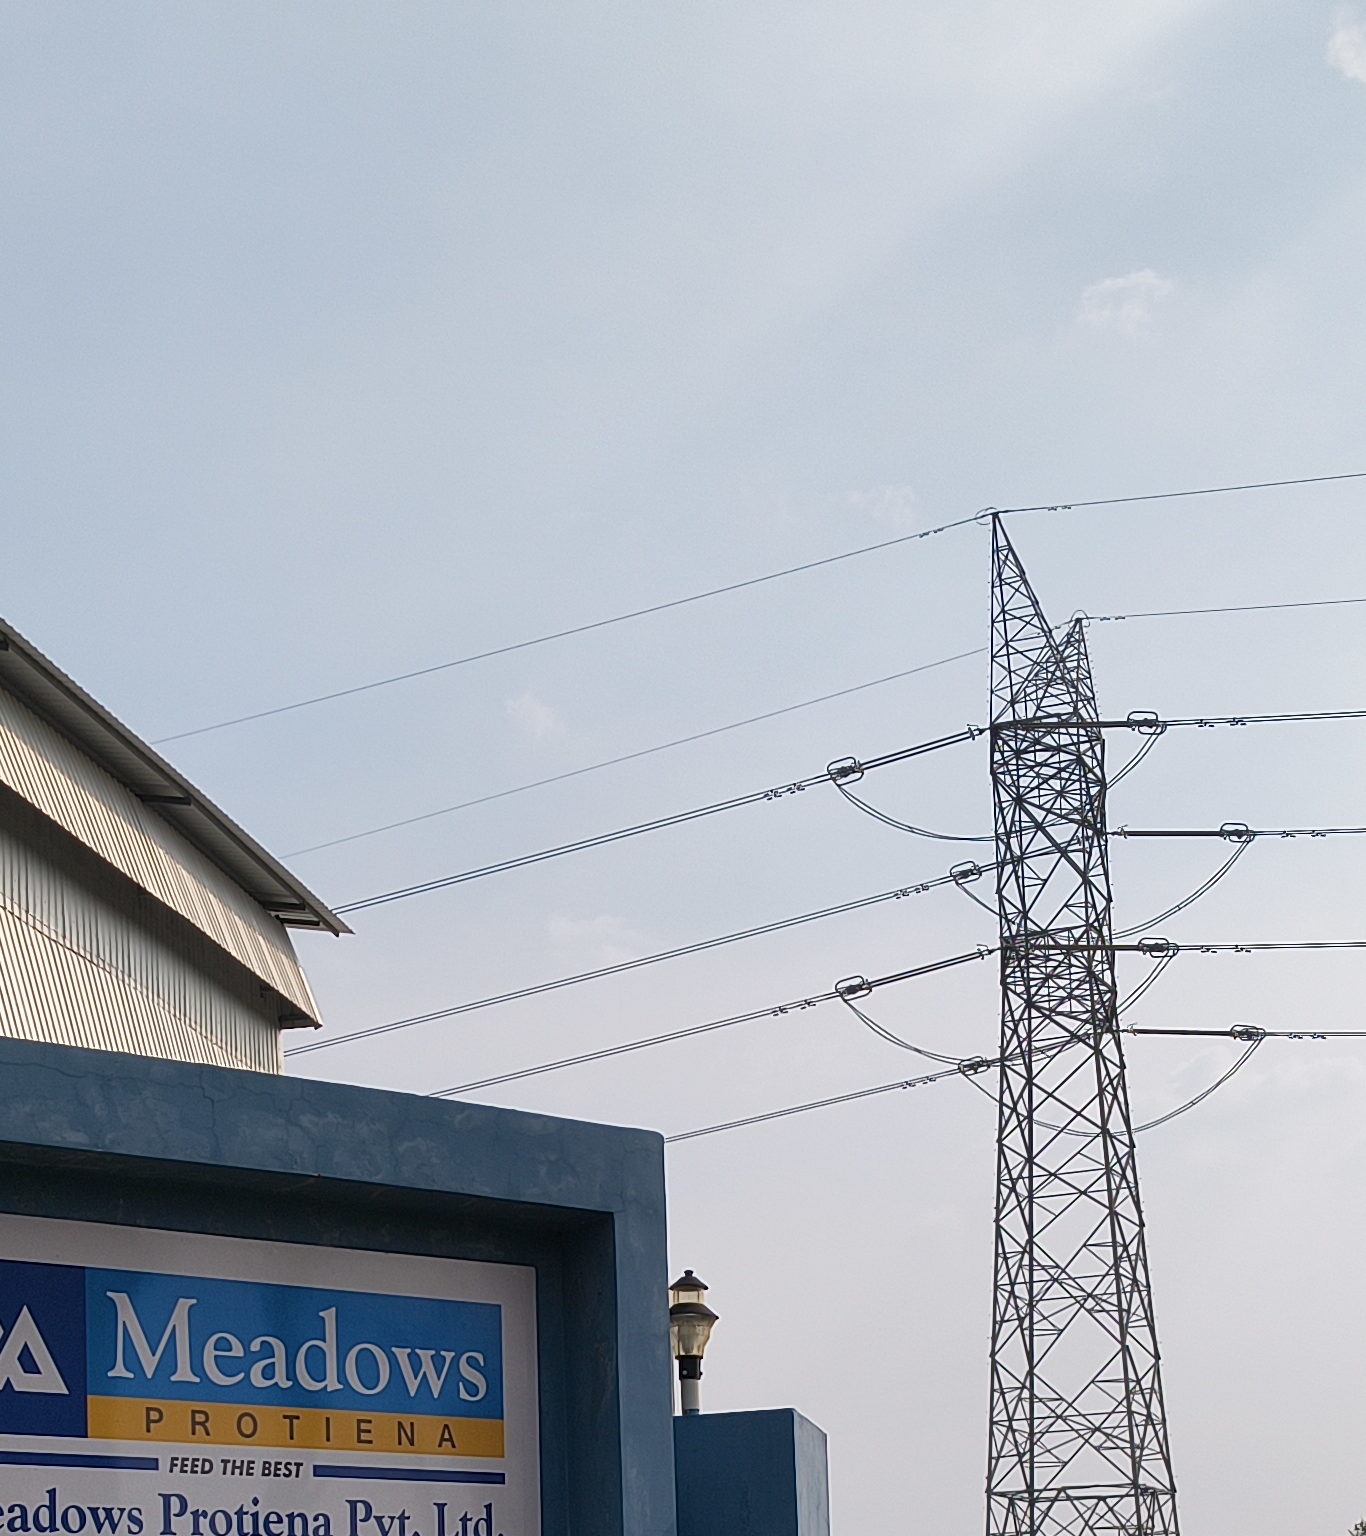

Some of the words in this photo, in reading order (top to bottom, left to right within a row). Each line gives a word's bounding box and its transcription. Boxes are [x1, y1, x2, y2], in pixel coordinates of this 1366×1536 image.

[105, 1290, 489, 1403] Meadows
[146, 1406, 458, 1450] PROTIENA
[168, 1456, 214, 1475] FEED
[220, 1458, 256, 1477] THE
[260, 1460, 304, 1479] BEST
